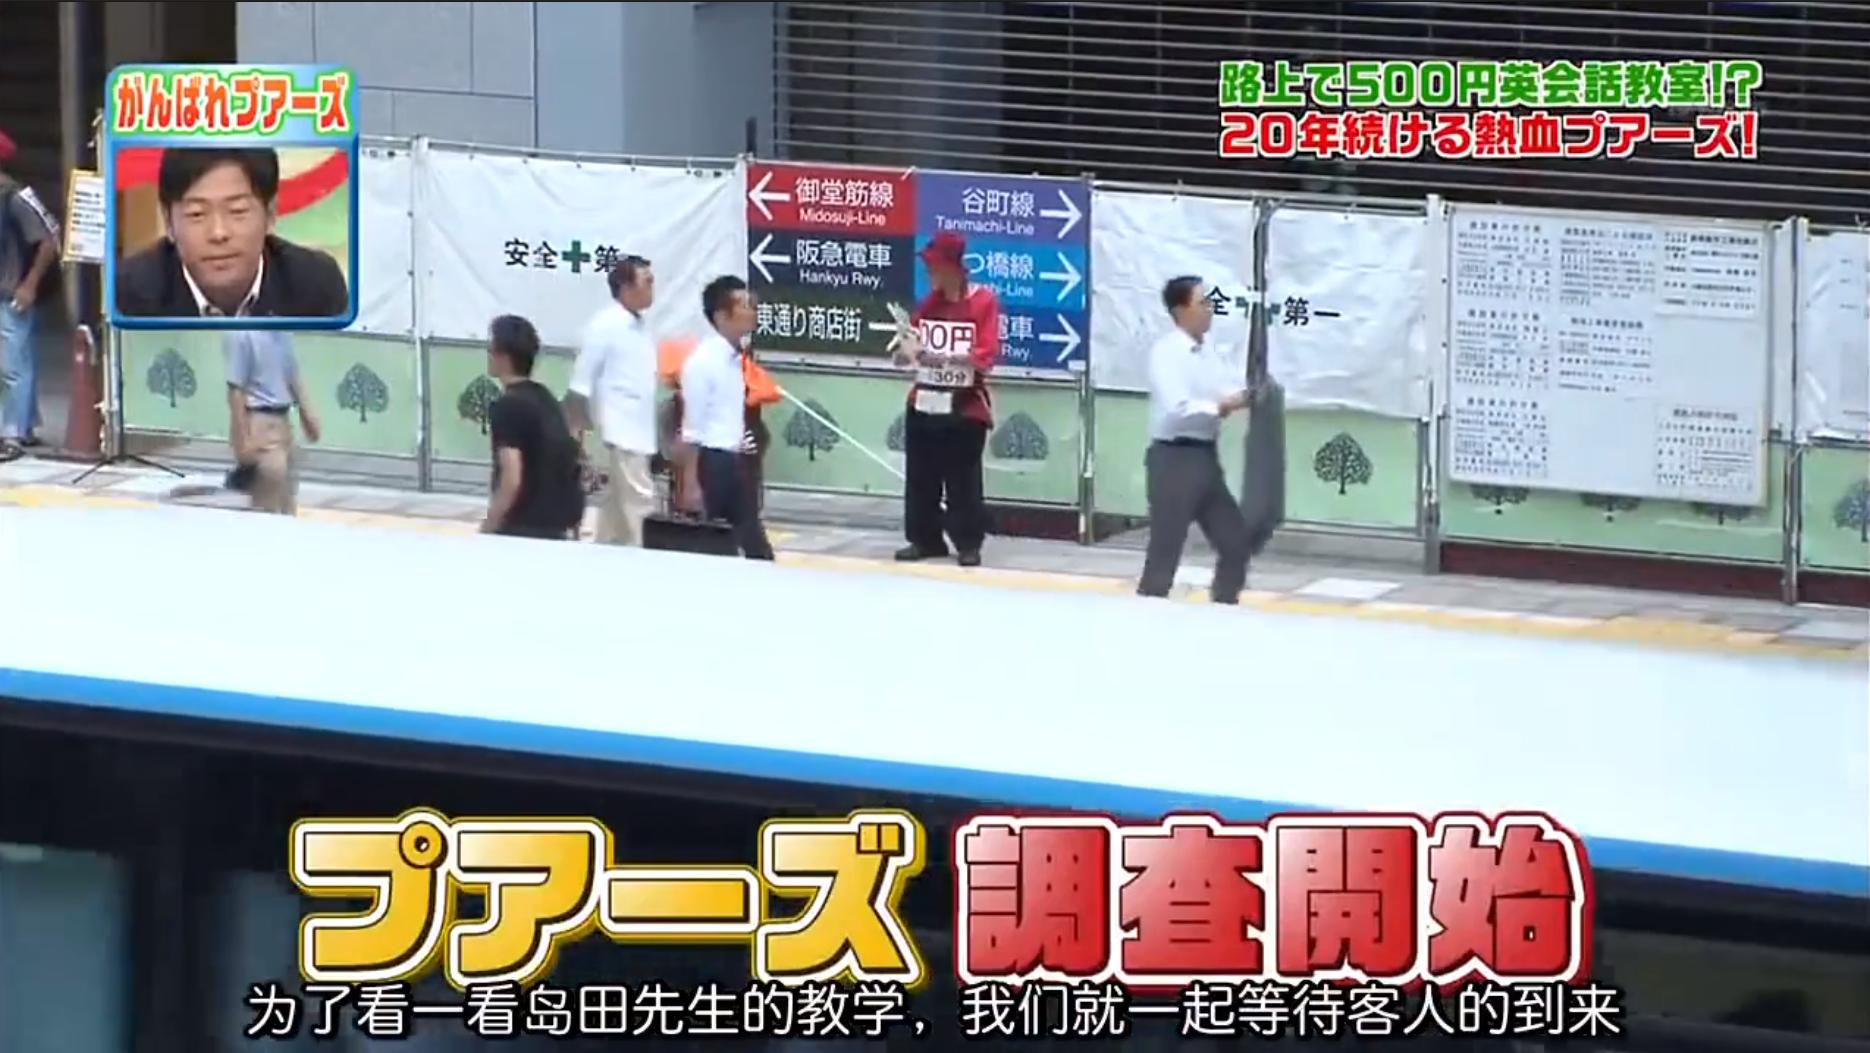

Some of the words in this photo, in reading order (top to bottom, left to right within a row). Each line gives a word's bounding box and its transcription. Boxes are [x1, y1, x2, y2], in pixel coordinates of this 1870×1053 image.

[795, 177, 894, 208] 御堂筋線
[962, 187, 1035, 217] 谷町線
[799, 208, 886, 227] Midosuji-Line
[936, 214, 1035, 236] Tanimachi-Line
[796, 239, 893, 270] 阪急電車
[962, 250, 1034, 280] つ橋線
[799, 269, 850, 288] Hankyu
[756, 302, 861, 342] 東通り商店街
